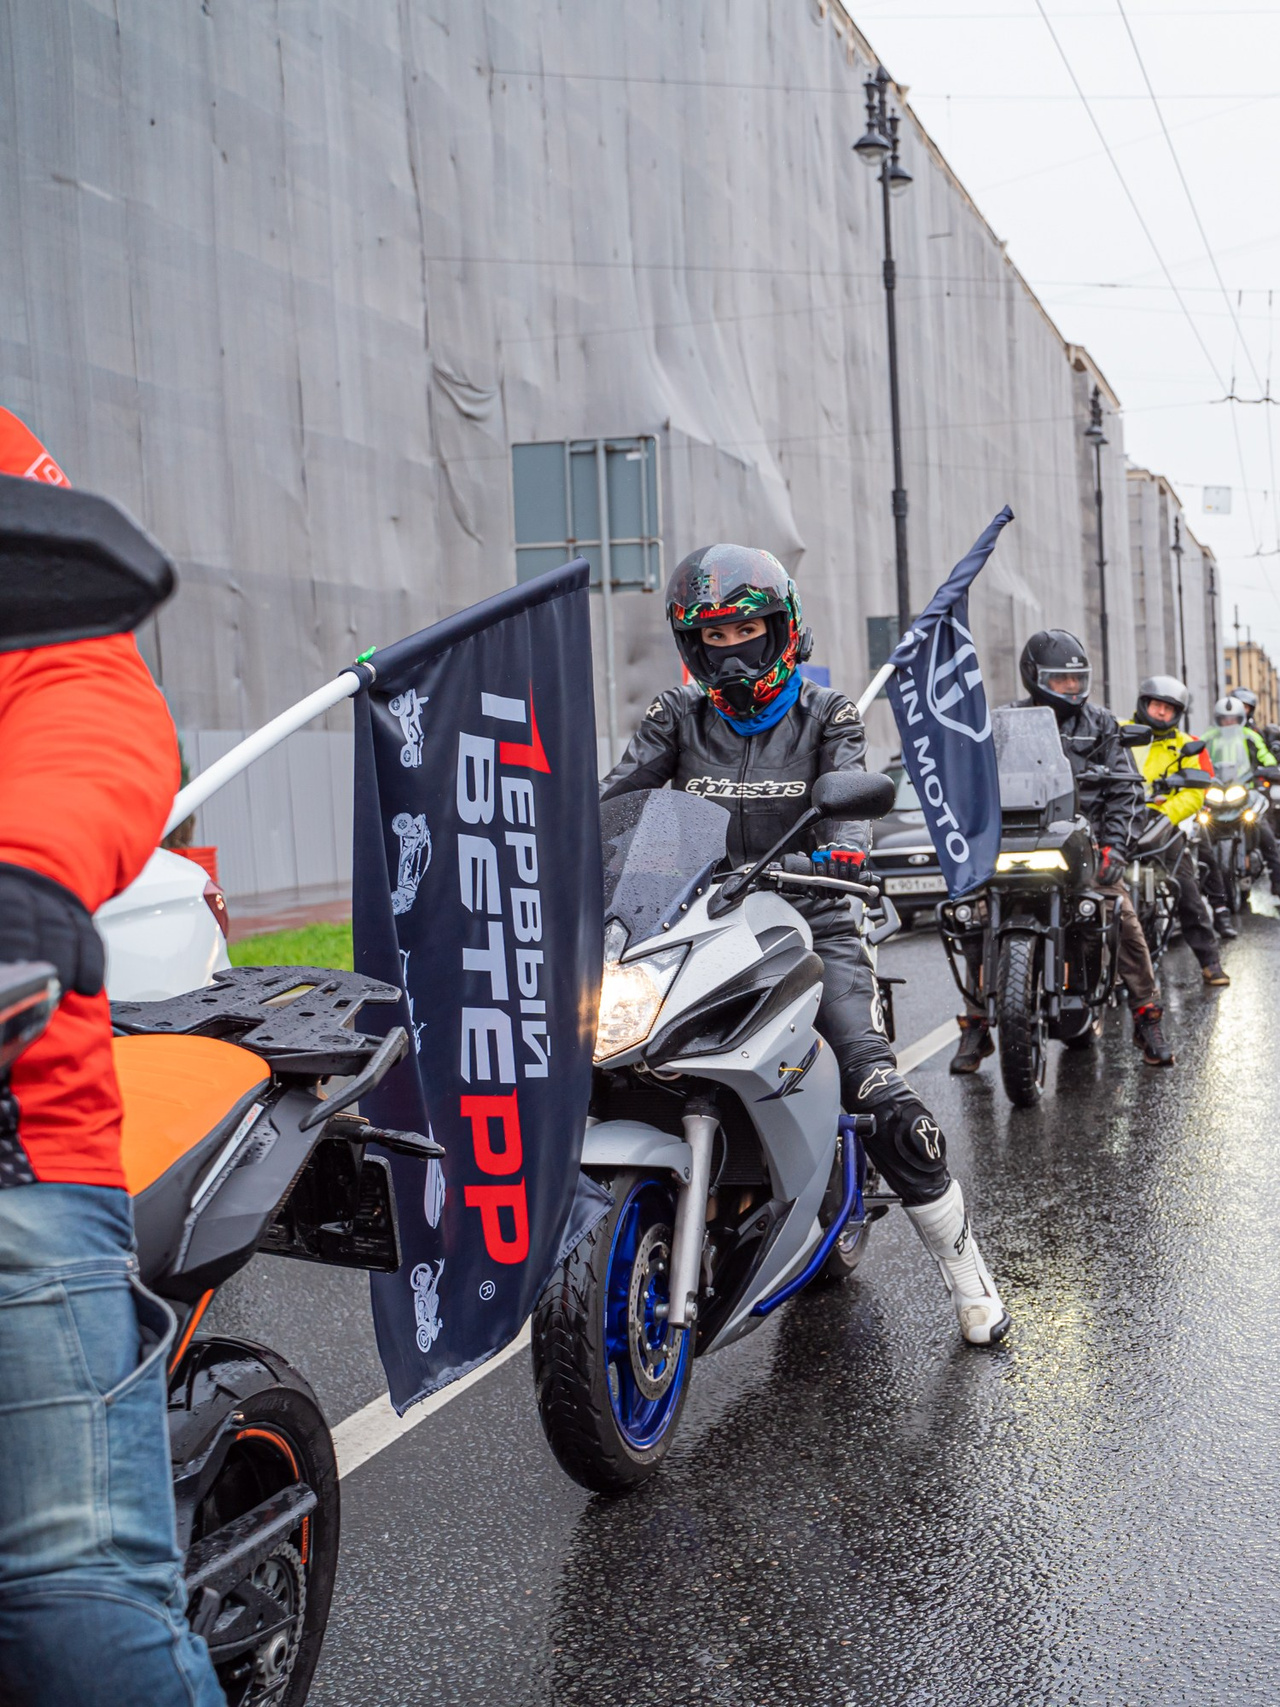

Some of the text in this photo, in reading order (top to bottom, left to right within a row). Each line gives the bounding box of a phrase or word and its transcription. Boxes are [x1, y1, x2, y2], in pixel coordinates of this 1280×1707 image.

[685, 776, 806, 799] alpinestars
[913, 735, 970, 864] MOTO
[457, 732, 530, 1265] ВЕТЕРР
